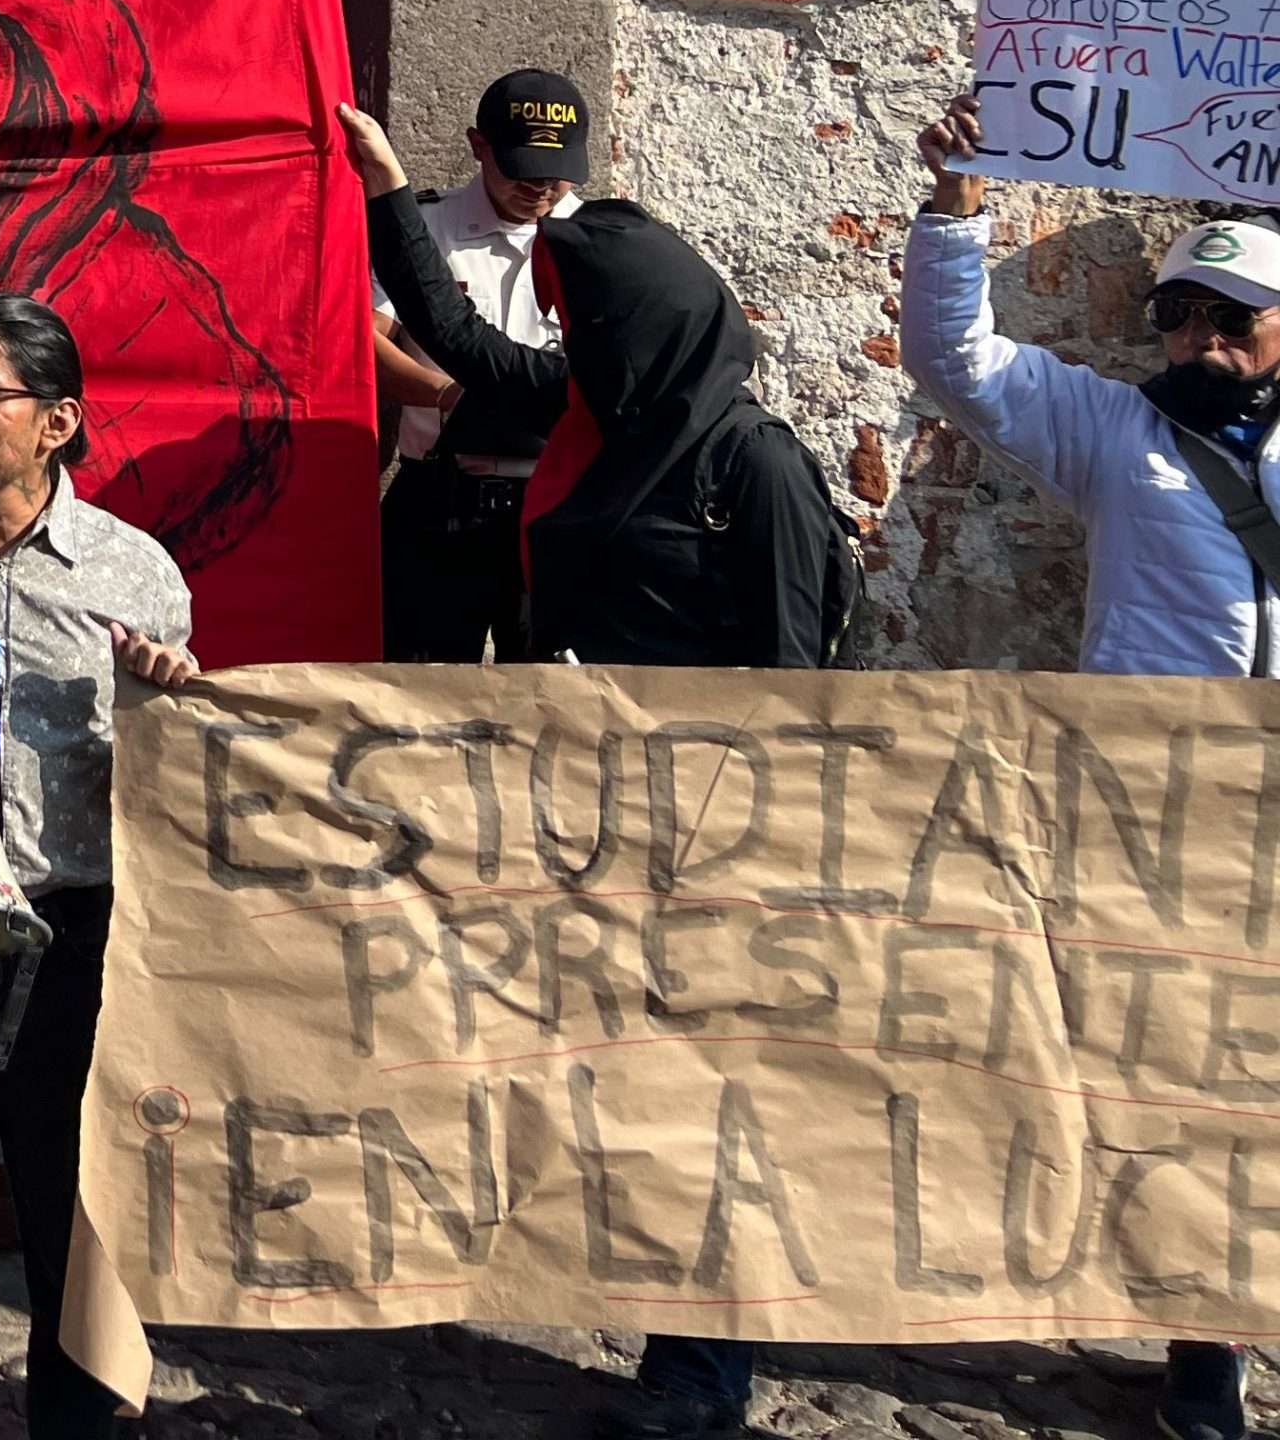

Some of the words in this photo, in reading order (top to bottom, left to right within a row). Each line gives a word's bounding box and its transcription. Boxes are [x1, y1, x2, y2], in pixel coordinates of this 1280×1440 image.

[986, 28, 1149, 77] Afuera
[510, 102, 577, 124] POLICIA
[567, 1062, 820, 1288] LA
